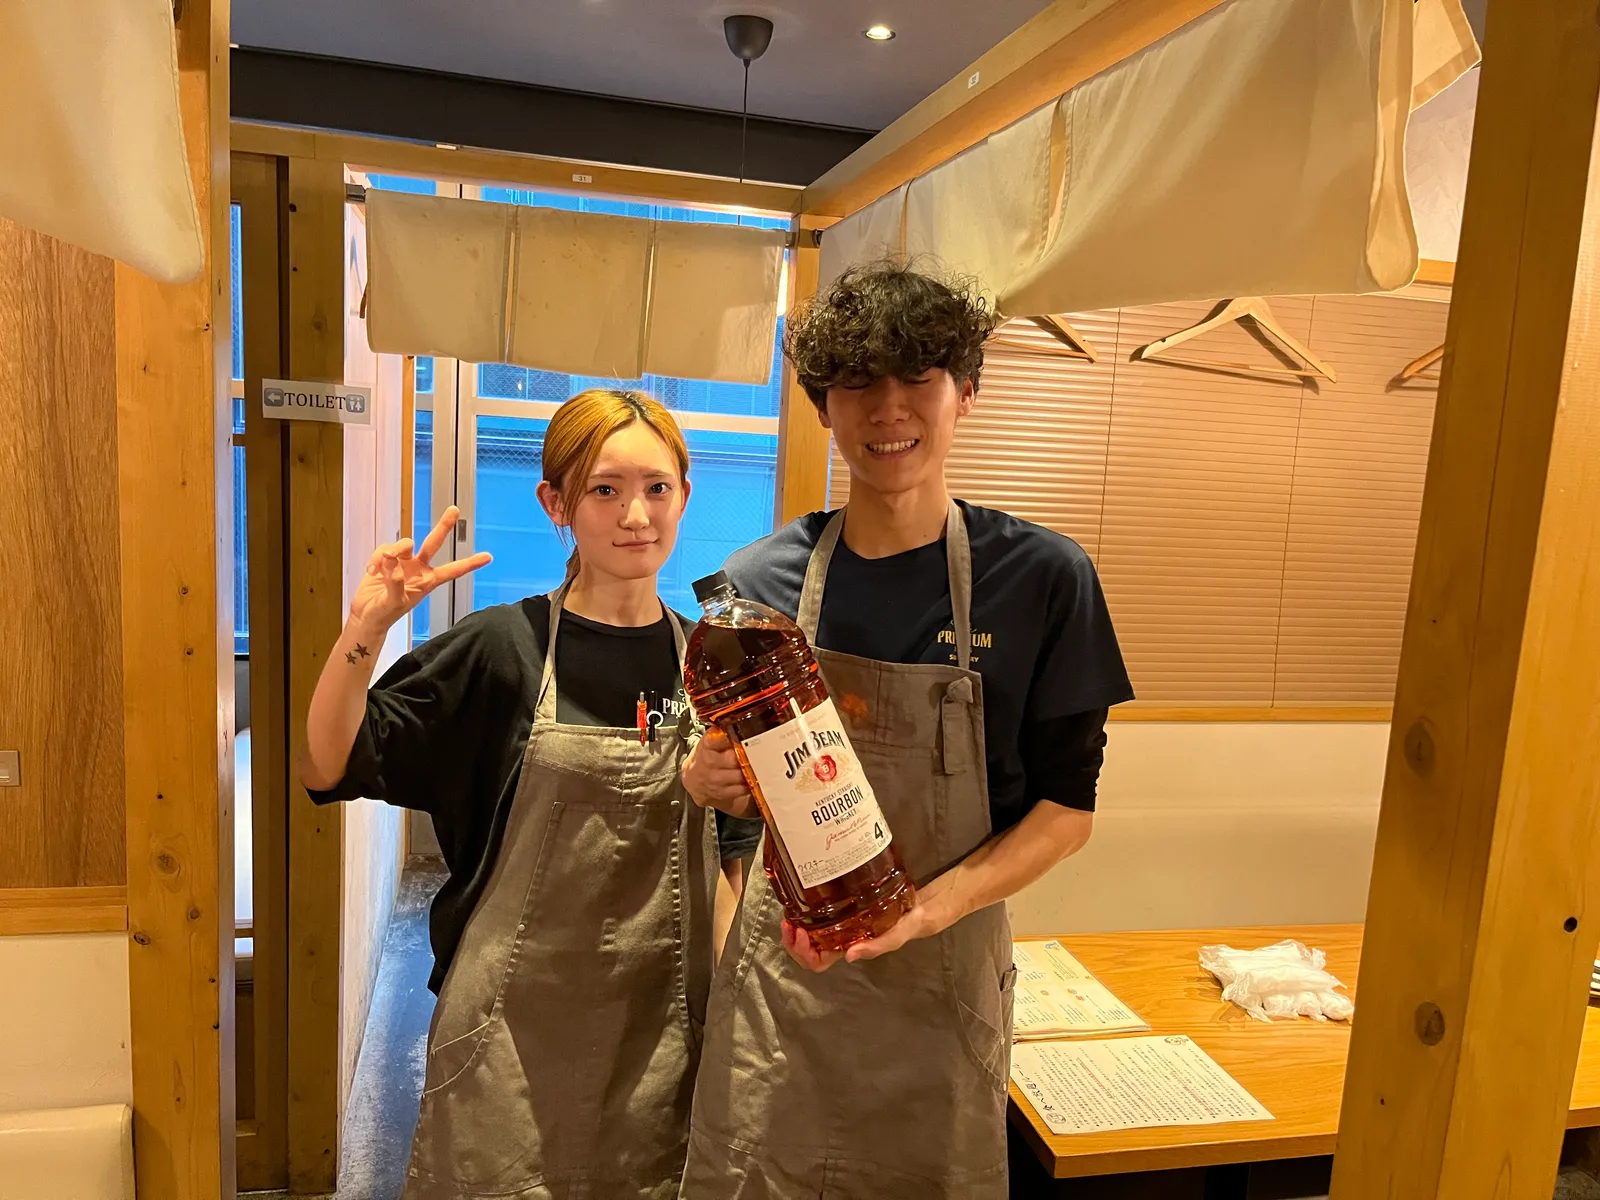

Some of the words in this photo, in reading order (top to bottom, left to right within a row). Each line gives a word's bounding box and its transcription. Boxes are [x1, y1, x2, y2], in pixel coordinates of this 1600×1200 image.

[284, 392, 345, 409] TOILET
[784, 741, 812, 779] JIM
[810, 730, 847, 750] BEAM
[811, 785, 864, 826] BOURBON
[815, 793, 837, 806] KENTUCKY
[874, 822, 884, 839] 4
[798, 860, 824, 872] ウイスキー
